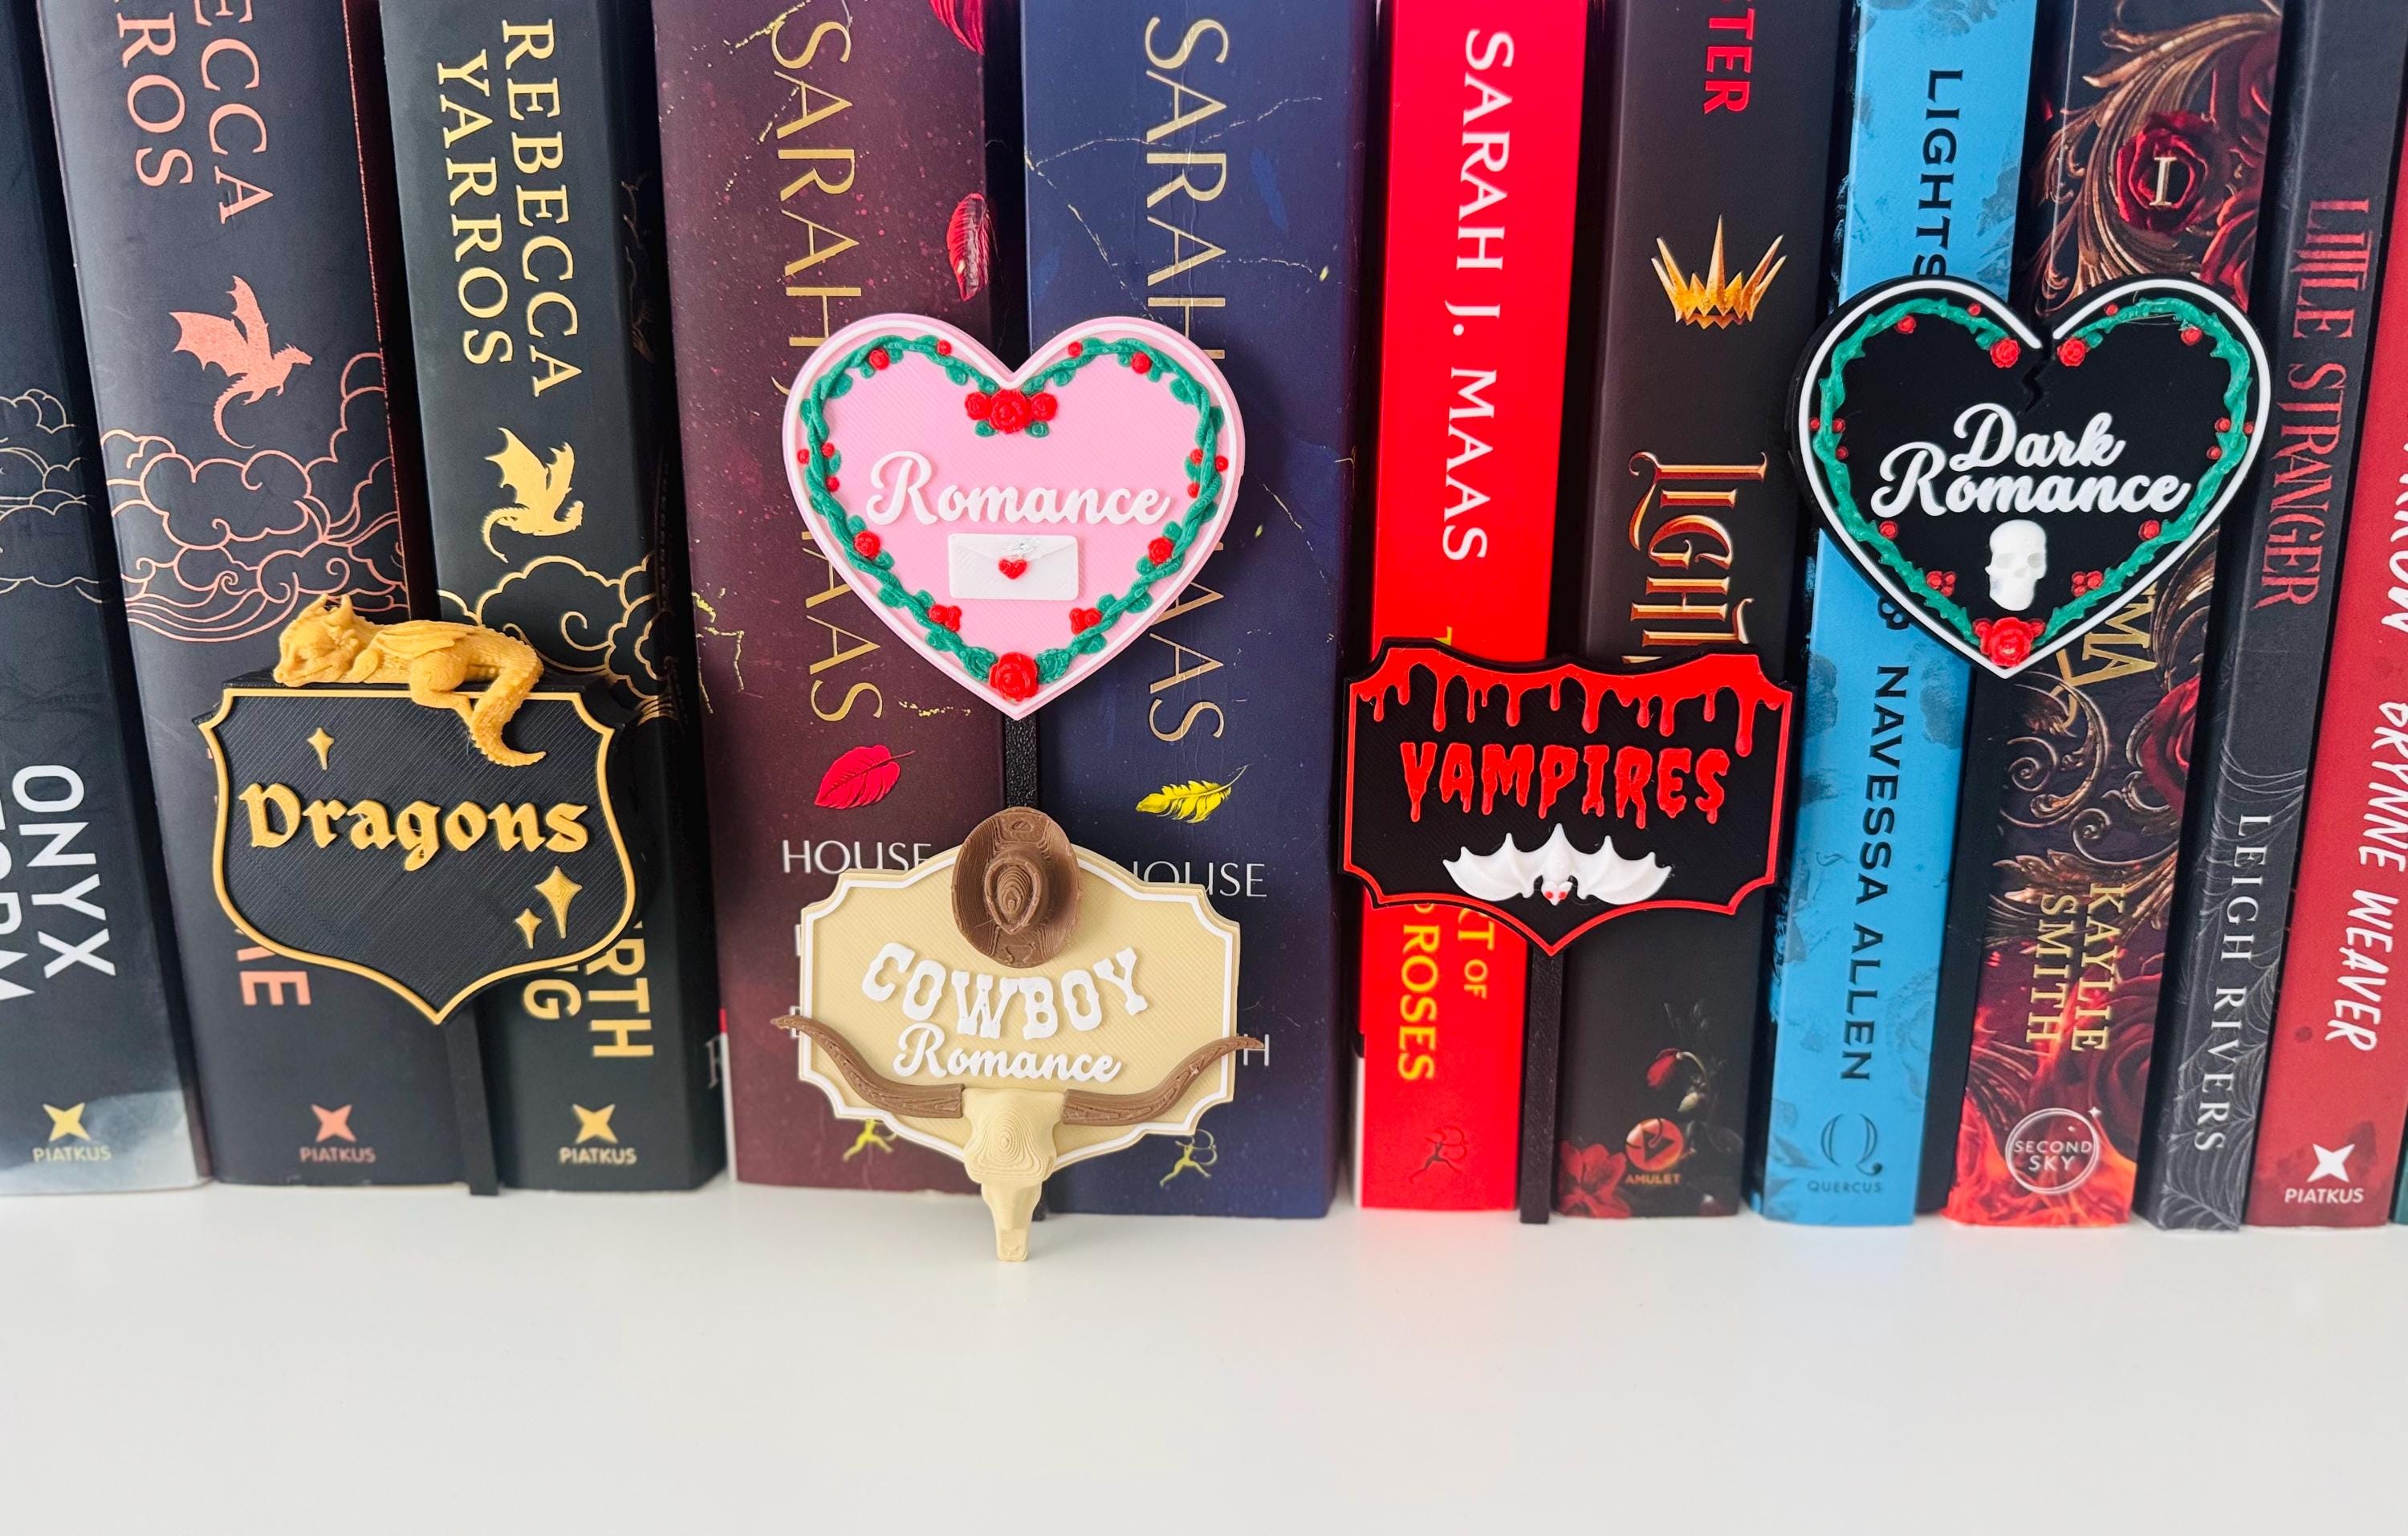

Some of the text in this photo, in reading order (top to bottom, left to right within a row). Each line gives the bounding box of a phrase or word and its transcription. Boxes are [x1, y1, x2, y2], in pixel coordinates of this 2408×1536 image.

[115, 0, 193, 187] ROS
[1703, 0, 1755, 114] TER
[437, 49, 514, 364] YARROS
[502, 18, 583, 397] REBECCA
[1442, 28, 1515, 561] SARAH J. MAAS
[771, 21, 884, 721] SARAH AAS
[1145, 16, 1229, 742] SARAH AAS
[2251, 199, 2373, 612] LITTLE STRANGER
[1870, 441, 2192, 518] Romance
[1948, 402, 2125, 471] Dark
[865, 450, 1171, 526] Romance
[1621, 451, 1767, 664] LIGHT
[238, 782, 589, 872] Dragons
[1399, 742, 1731, 829] VAMPIRES
[11, 764, 117, 979] ONYX
[782, 839, 933, 875] HOUSE
[1113, 860, 1268, 897] OUSE
[1840, 664, 1910, 1081] NAVESSA ALLEN
[860, 941, 1149, 1041] COWBOY
[1397, 924, 1440, 1081] ROSES
[1463, 959, 1489, 1000] OF
[2026, 893, 2078, 1043] SMITH
[2071, 883, 2127, 1050] KAYLIE
[2193, 814, 2272, 1153] LEIGH RIVERS
[2325, 888, 2399, 1051] WEAVER
[893, 1022, 1122, 1083] Romance
[32, 1145, 112, 1163] PIATKUS
[299, 1146, 376, 1164] PIATKUS
[559, 1146, 637, 1164] PIATKUS
[1625, 1172, 1682, 1185] AMULET
[1807, 1180, 1883, 1194] QUERCUS
[2013, 1139, 2093, 1154] SECOND
[2028, 1154, 2076, 1172] SKY
[2284, 1187, 2365, 1205] PIATKUS
